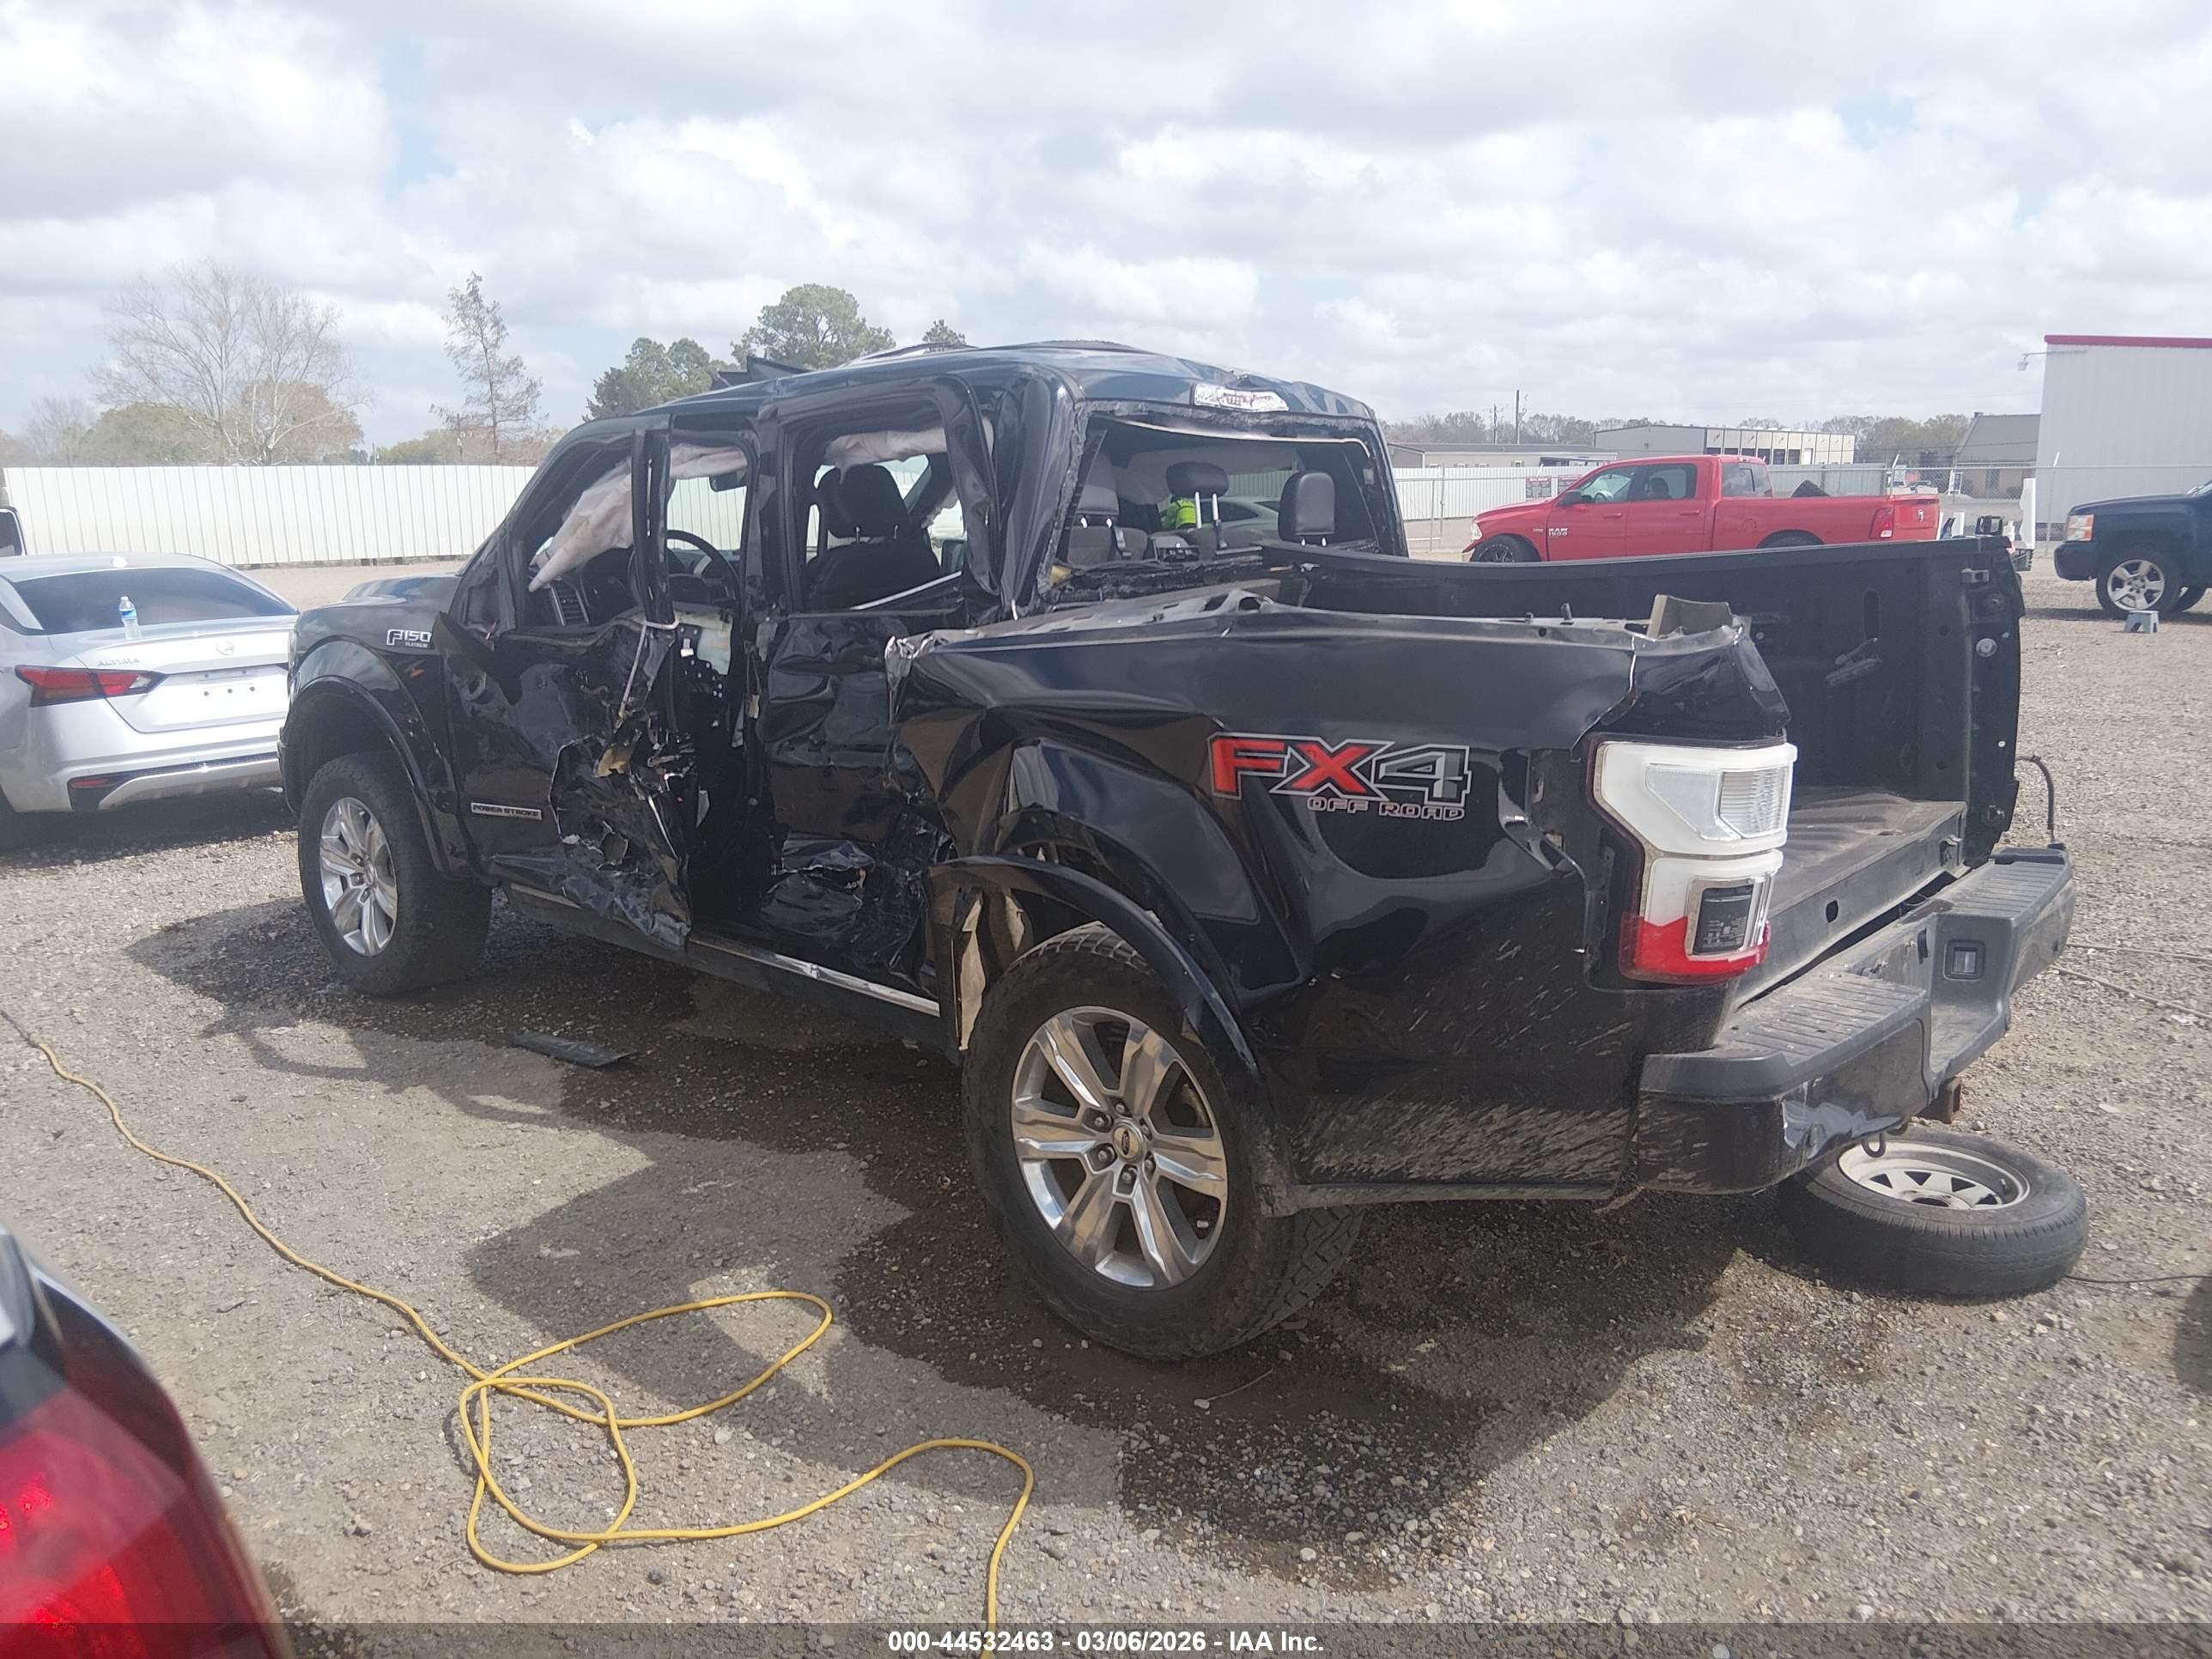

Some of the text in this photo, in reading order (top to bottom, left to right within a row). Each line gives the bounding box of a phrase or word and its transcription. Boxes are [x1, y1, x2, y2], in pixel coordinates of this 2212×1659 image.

[1207, 732, 1472, 807] FX4
[473, 804, 539, 817] POWER STROKE
[1307, 796, 1465, 821] OFF ROAD
